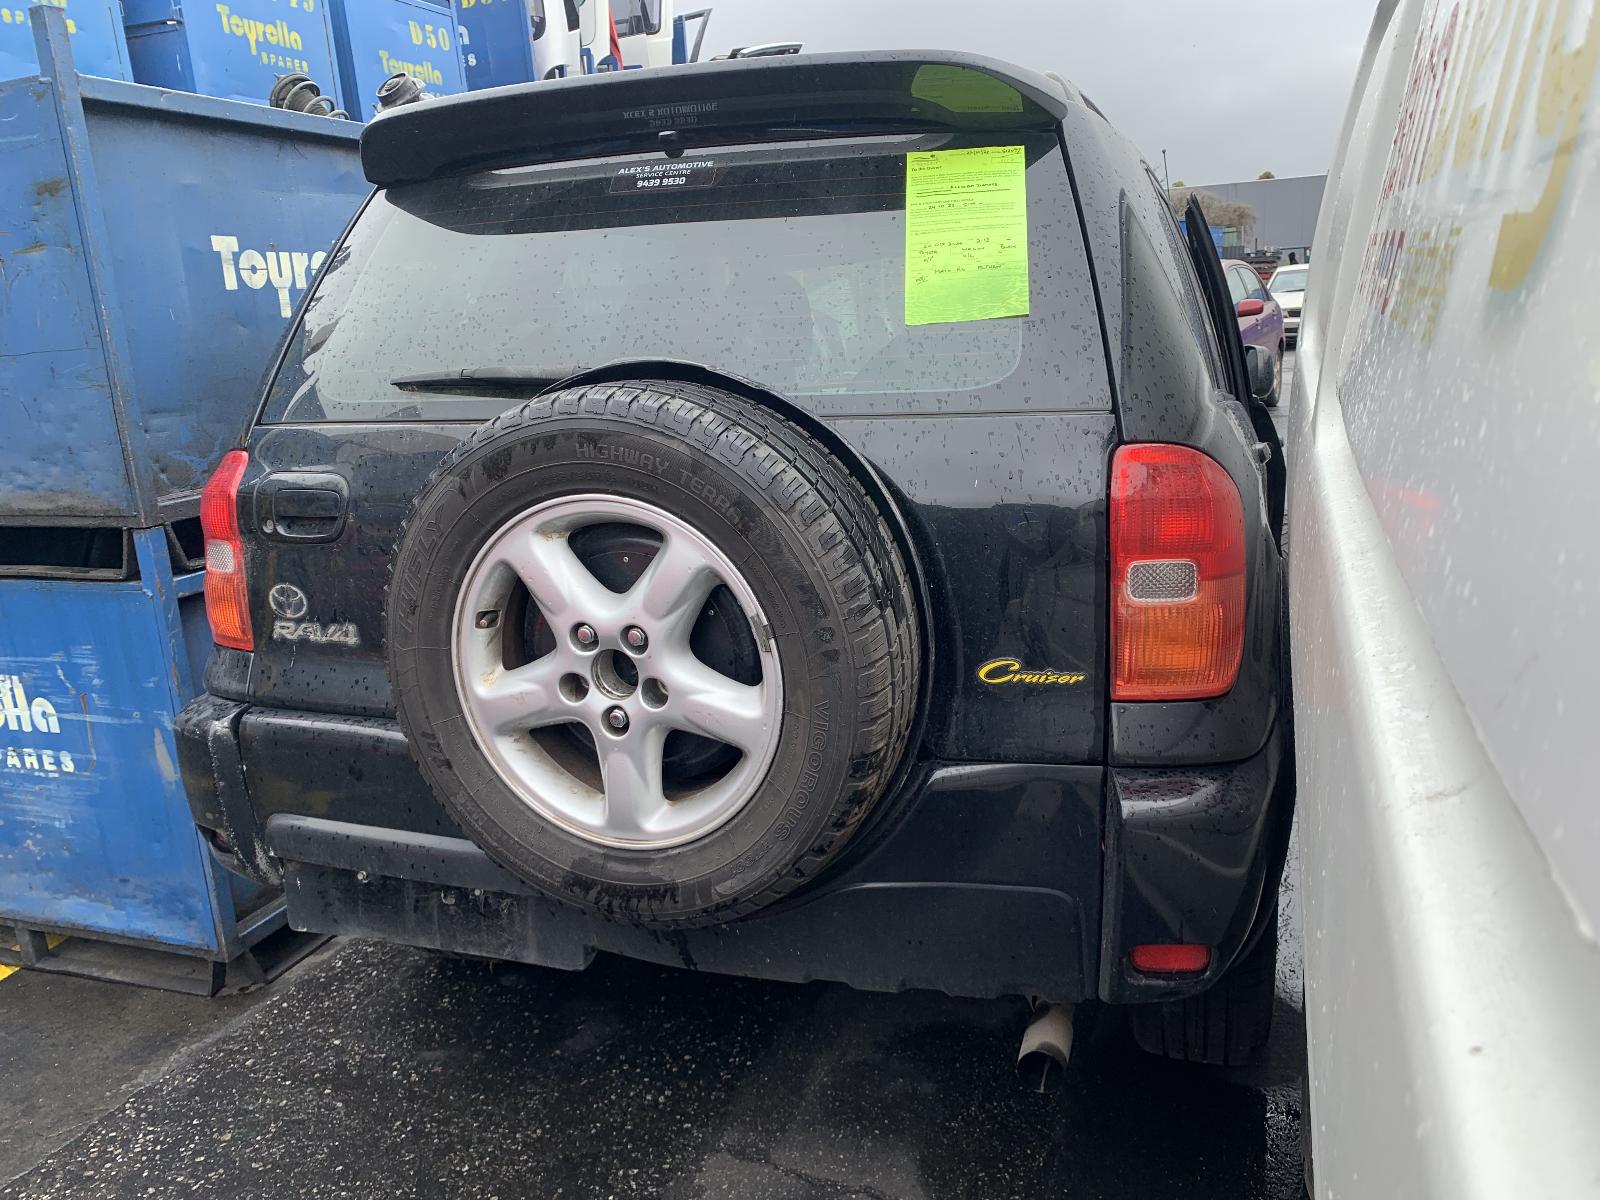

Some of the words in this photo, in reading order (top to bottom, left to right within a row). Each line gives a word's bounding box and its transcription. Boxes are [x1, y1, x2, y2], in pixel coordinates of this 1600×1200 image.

[408, 20, 450, 51] D50
[261, 51, 309, 73] SPARES
[618, 165, 651, 175] ALEX'S
[652, 160, 715, 171] AUTOMOTIVE
[636, 178, 660, 188] 9439
[661, 176, 686, 185] 9530
[575, 442, 670, 474] HIGHWAY
[272, 620, 360, 647] RAV4
[977, 657, 1086, 685] Cruiser
[775, 699, 831, 841] VIGOROUS
